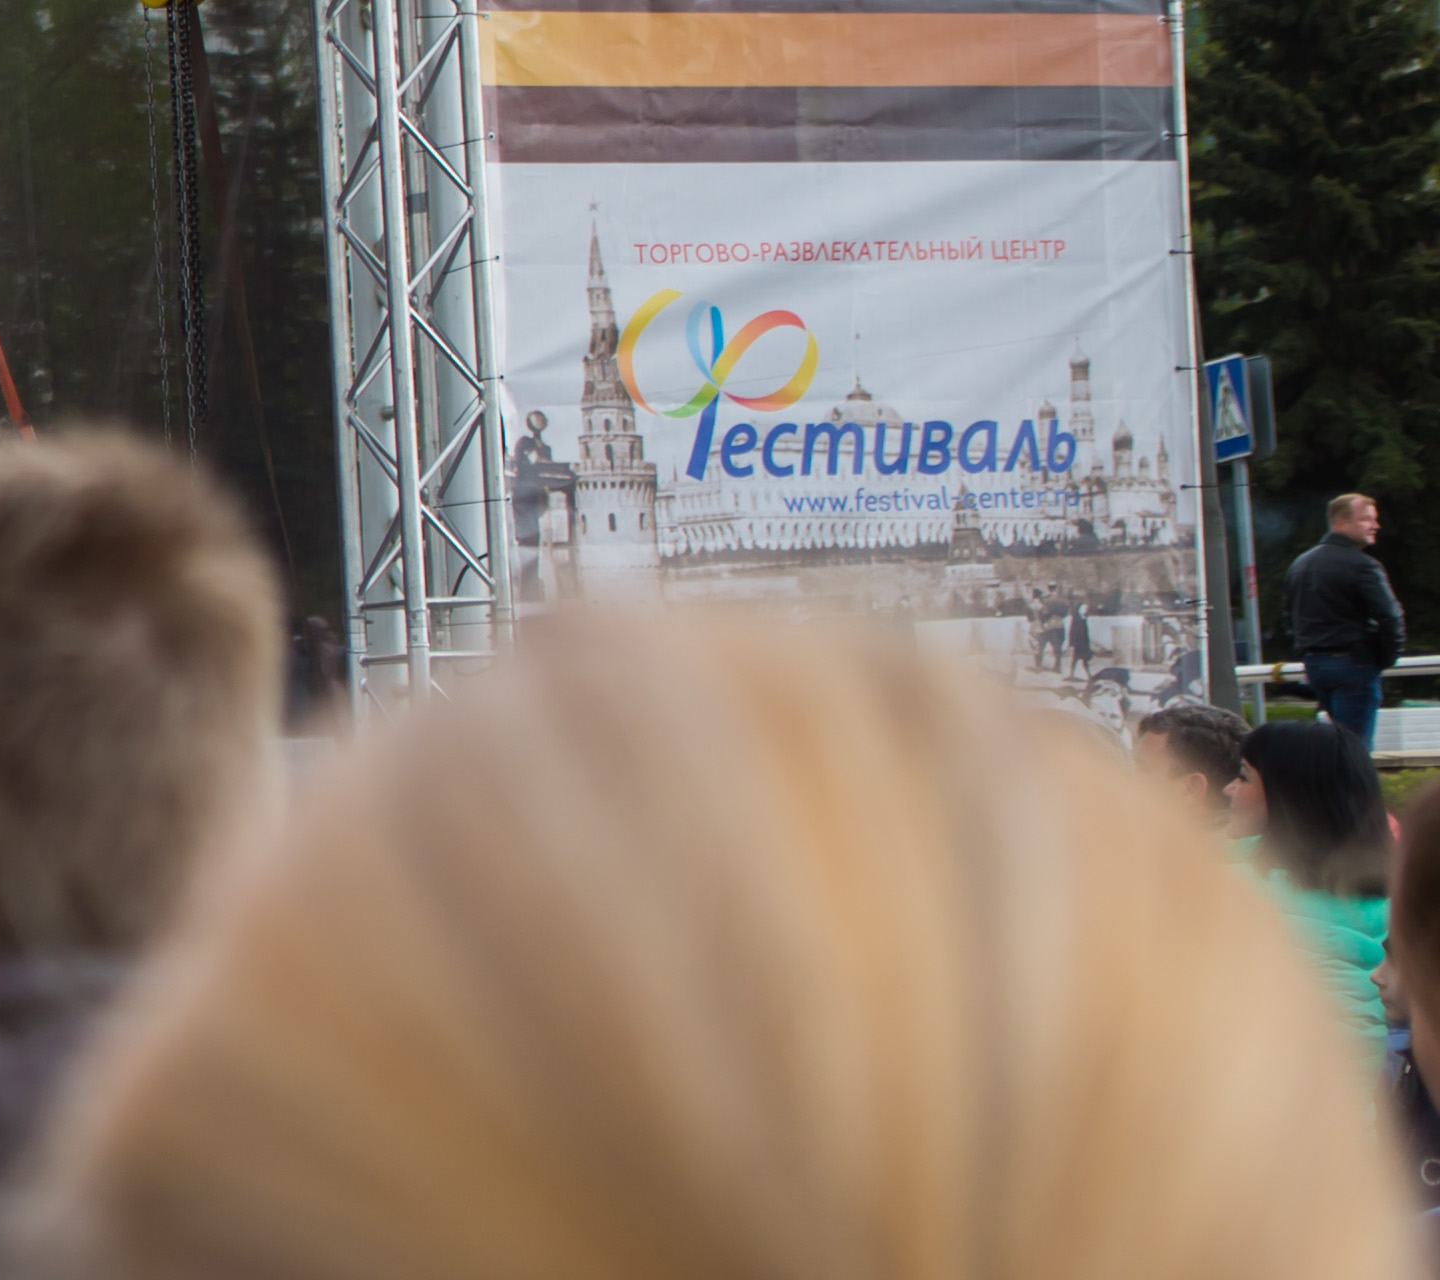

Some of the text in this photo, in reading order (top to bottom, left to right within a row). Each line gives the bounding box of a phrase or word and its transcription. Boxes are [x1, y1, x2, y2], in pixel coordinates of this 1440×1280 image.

[633, 237, 1067, 265] ТОРГОВО-РАЗВЛЕКАТЕЛЬНЫЙ ЦЕНТР
[617, 289, 1077, 480] Фестиваль
[783, 485, 1079, 515] www.festival-center.ru
